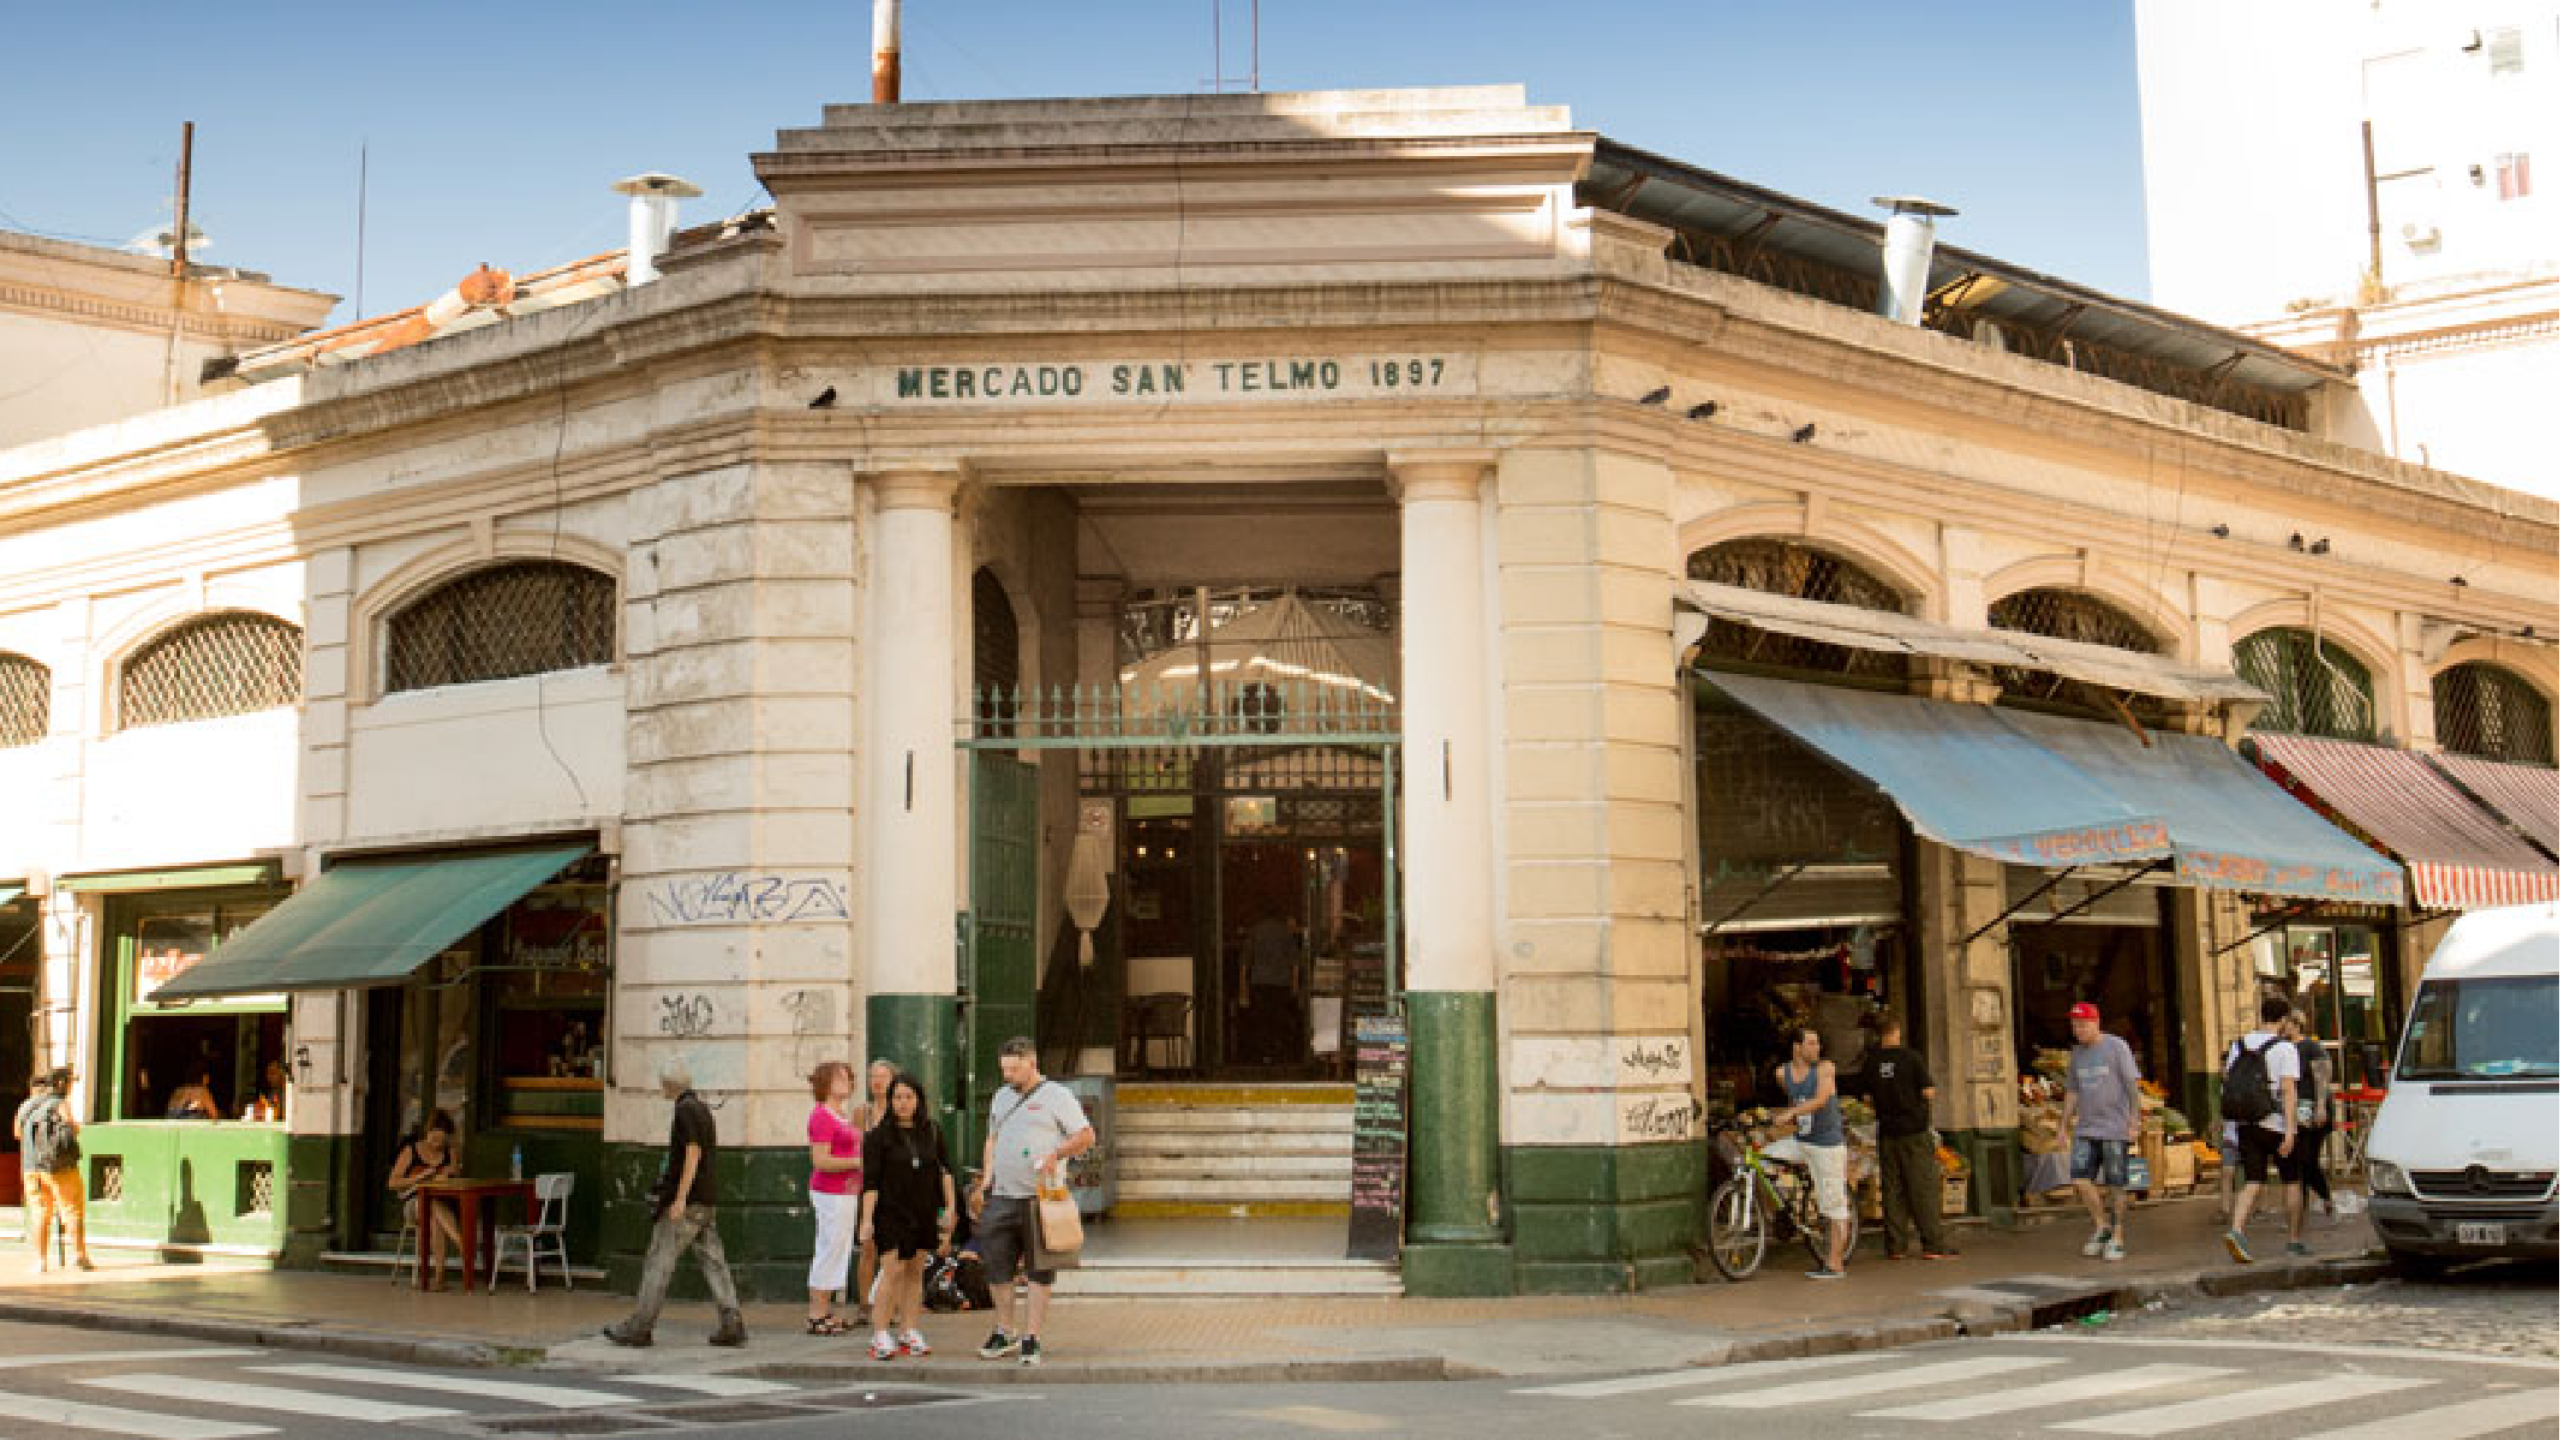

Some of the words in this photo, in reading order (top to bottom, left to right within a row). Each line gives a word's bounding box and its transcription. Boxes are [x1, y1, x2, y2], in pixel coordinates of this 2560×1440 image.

[897, 366, 1083, 398] MERCADO
[1111, 364, 1186, 393] SAN
[1213, 360, 1341, 391] TELMO
[1369, 359, 1445, 386] 1897
